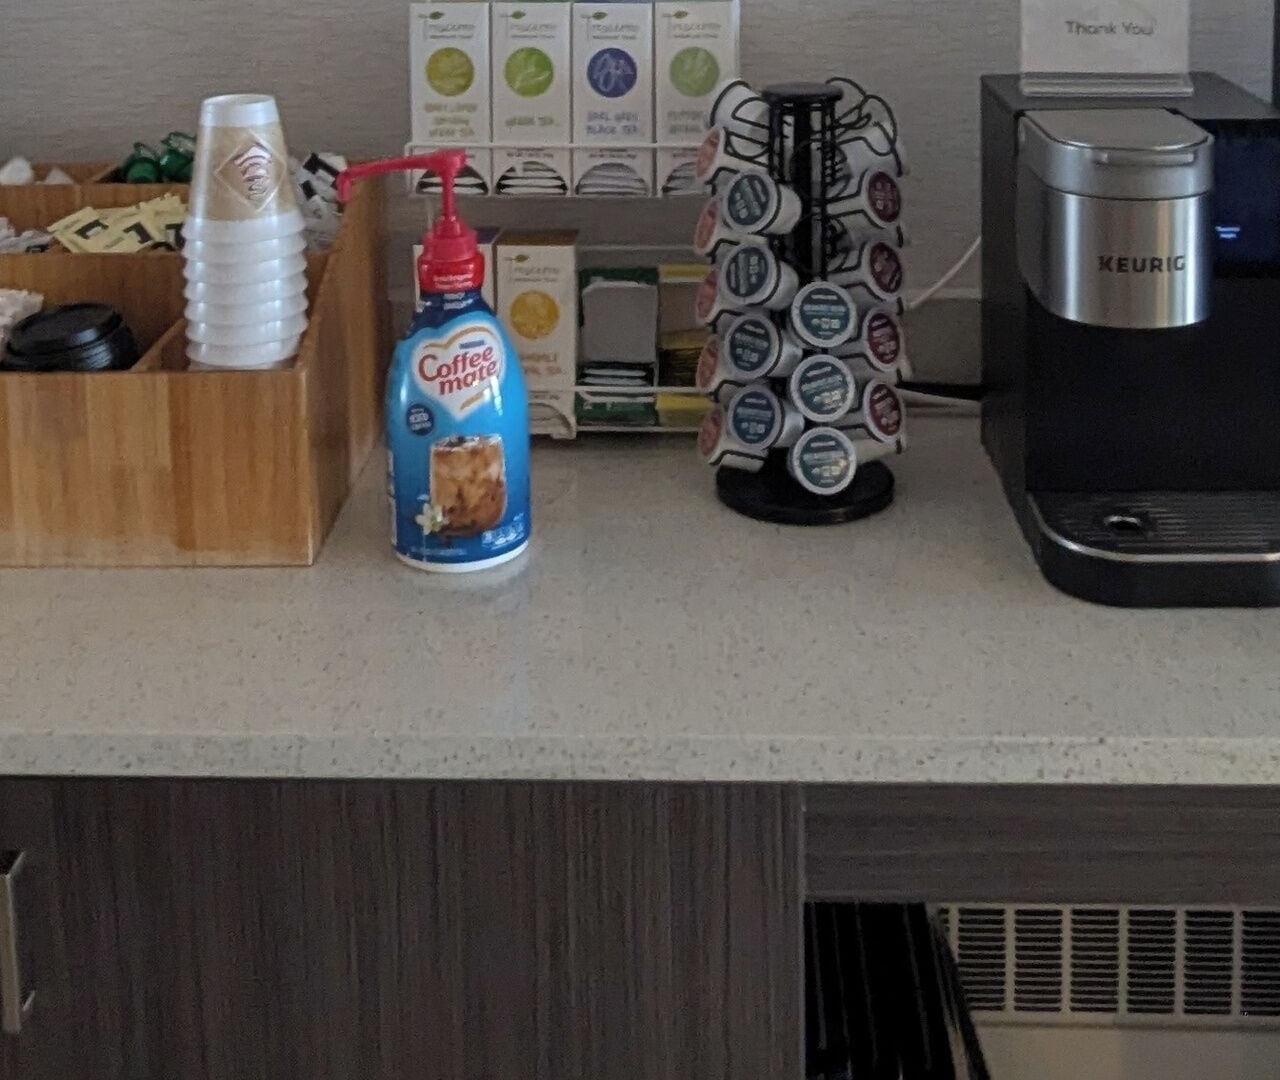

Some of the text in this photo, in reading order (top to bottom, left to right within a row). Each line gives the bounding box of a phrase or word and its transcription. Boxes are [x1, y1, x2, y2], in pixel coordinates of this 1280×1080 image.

[1065, 20, 1154, 36] Thank You
[1097, 255, 1187, 273] KEURIG
[418, 346, 494, 382] Coffee
[438, 361, 497, 395] mate
